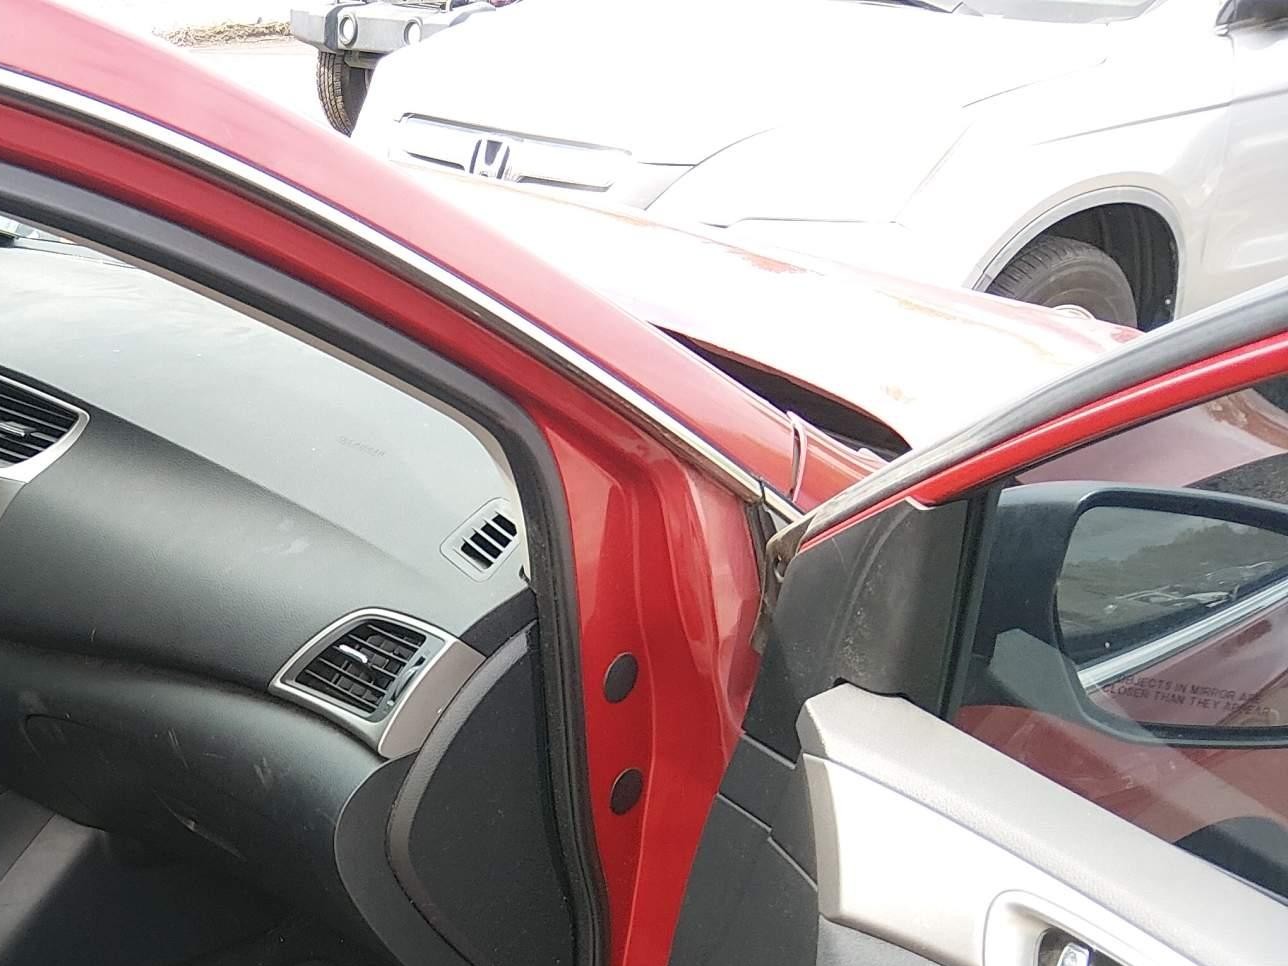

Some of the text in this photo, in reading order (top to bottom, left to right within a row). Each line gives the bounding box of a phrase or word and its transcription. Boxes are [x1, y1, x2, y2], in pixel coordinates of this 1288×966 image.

[1103, 686, 1149, 699] CLOSER
[1154, 691, 1186, 704] THAN
[1191, 697, 1219, 709] THEY
[1175, 683, 1189, 693] IN
[1191, 685, 1236, 699] MIRROR
